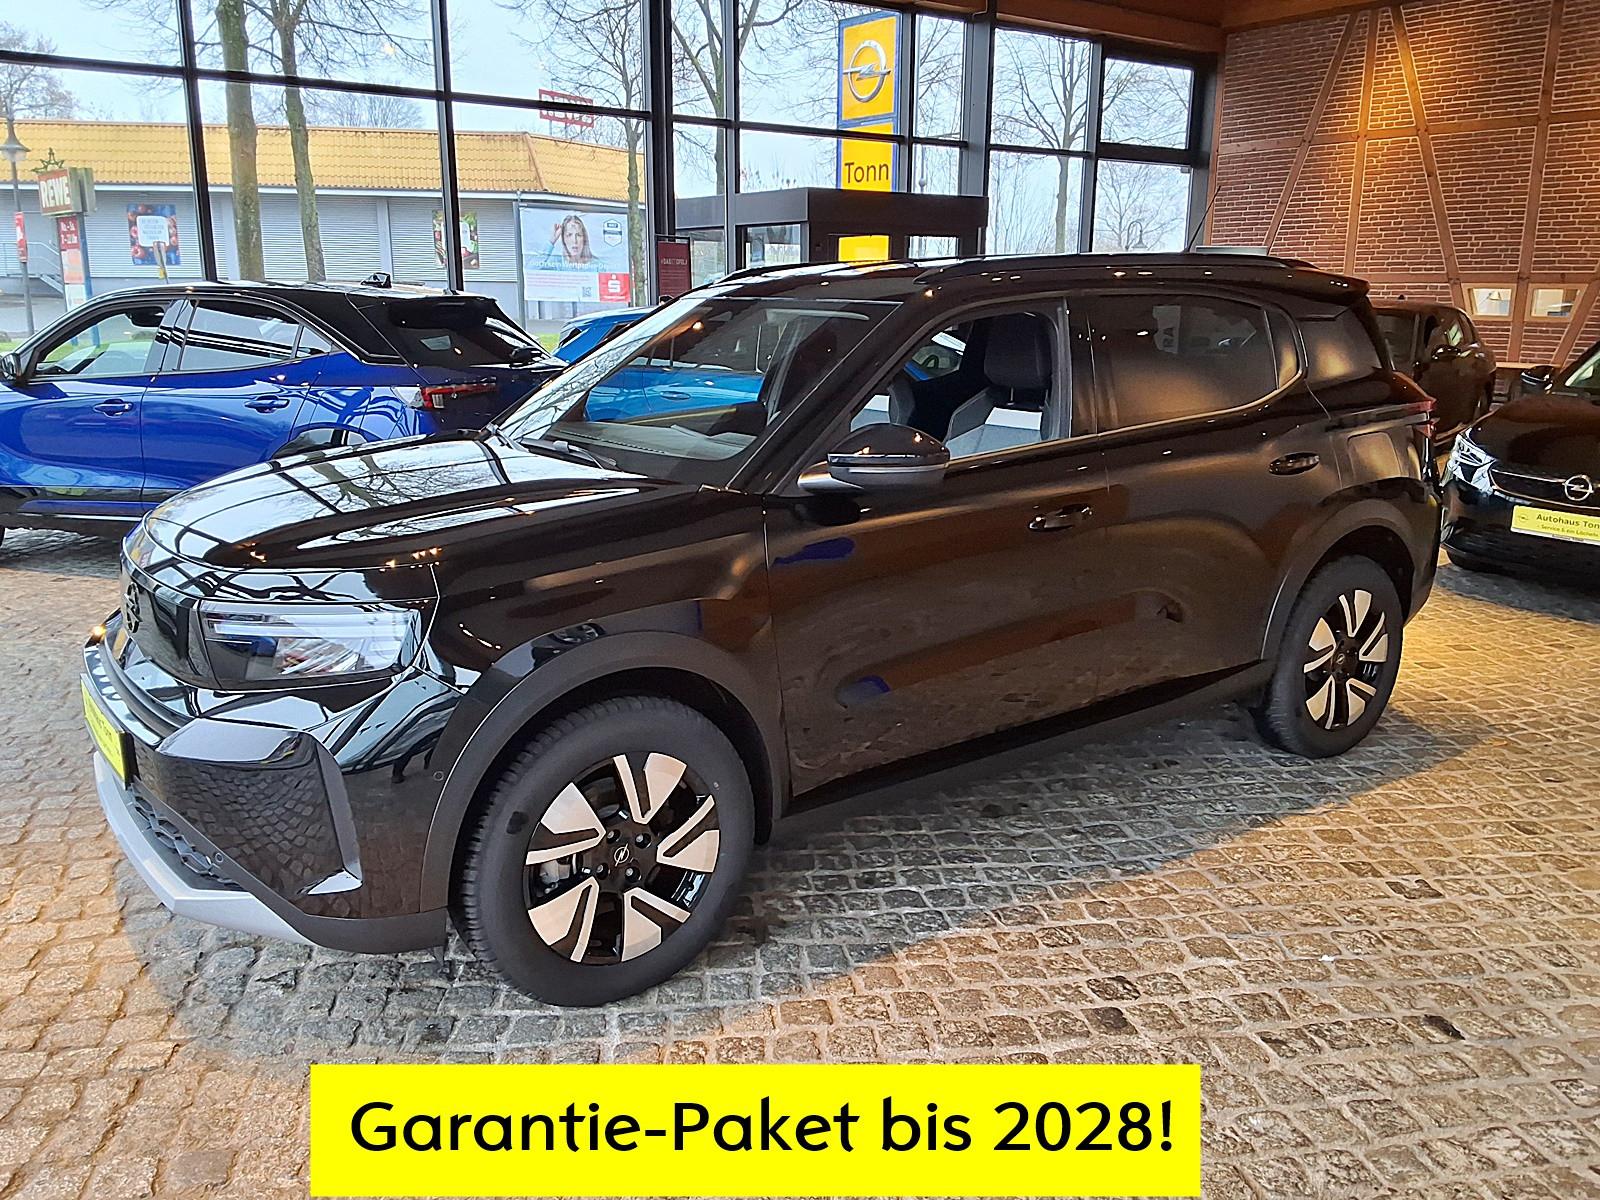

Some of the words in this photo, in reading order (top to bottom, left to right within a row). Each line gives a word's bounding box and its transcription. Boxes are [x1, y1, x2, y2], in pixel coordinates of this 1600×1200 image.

[844, 162, 889, 184] Tonn
[40, 176, 70, 208] REWE
[1536, 514, 1580, 527] Autohaus
